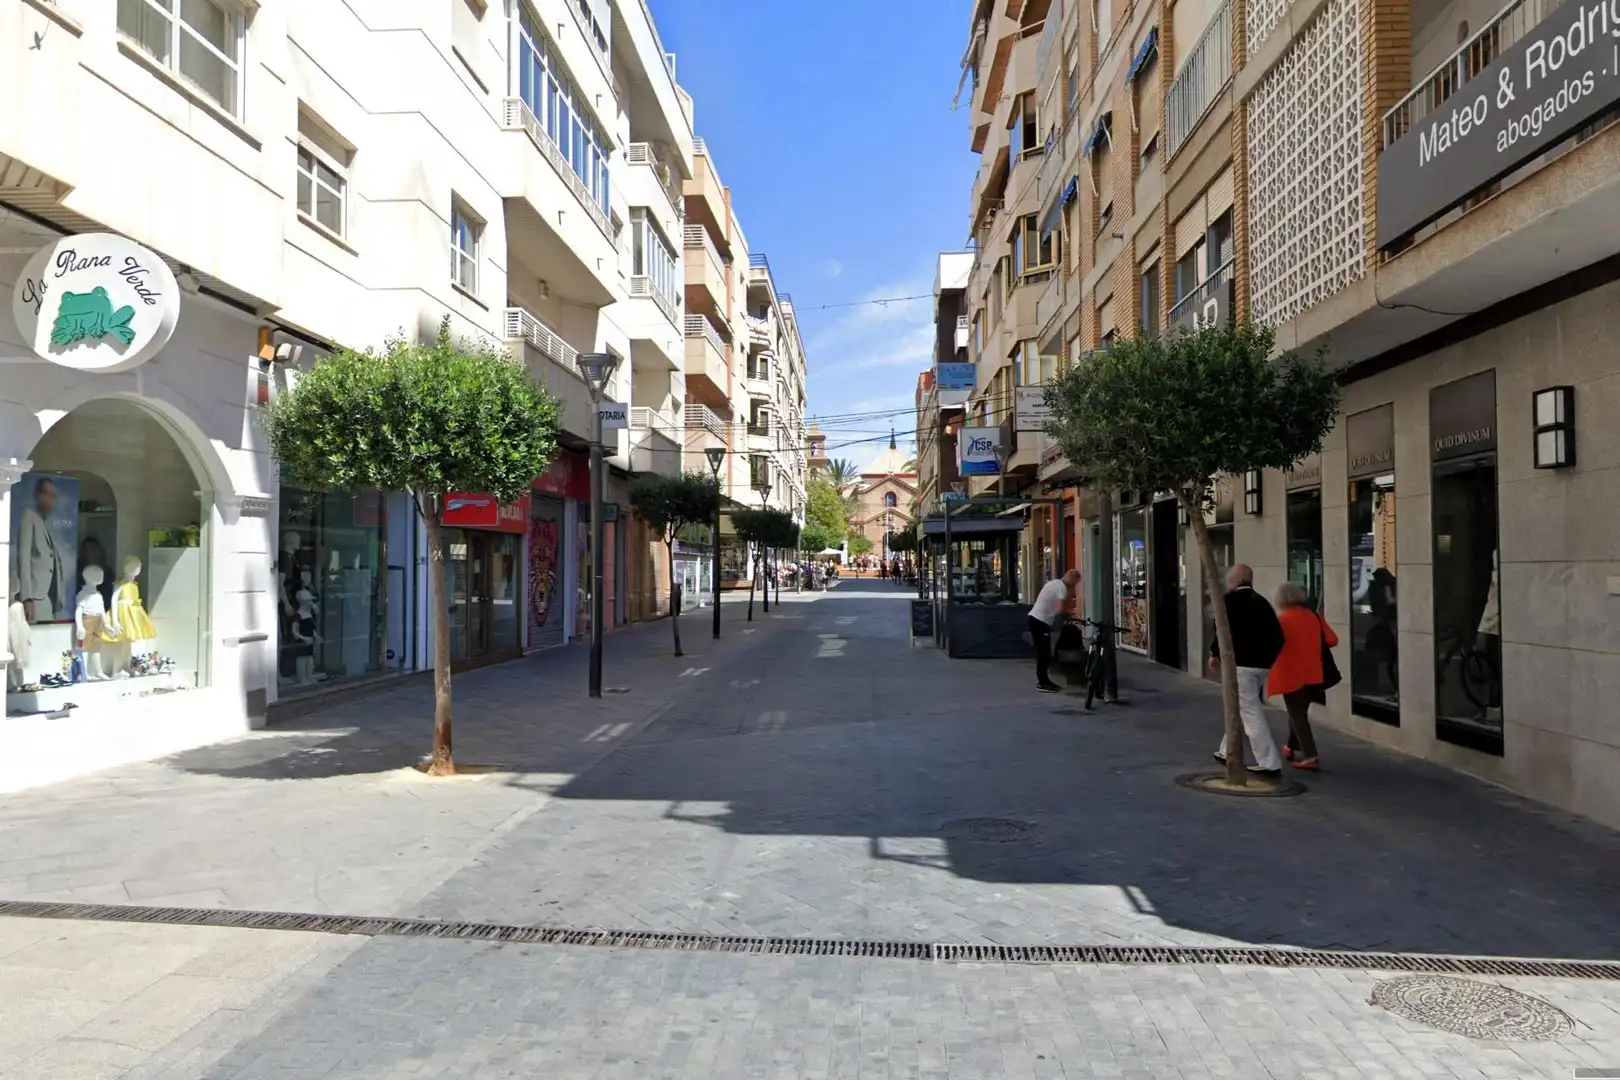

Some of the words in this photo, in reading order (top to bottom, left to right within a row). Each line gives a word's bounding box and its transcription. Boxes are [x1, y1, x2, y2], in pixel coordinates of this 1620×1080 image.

[1419, 94, 1488, 167] Mateo
[1496, 66, 1516, 109] &
[1496, 70, 1595, 152] abogados
[21, 276, 49, 316] La
[54, 248, 112, 278] Rana
[117, 256, 163, 306] Verde
[599, 410, 625, 421] OTARIA
